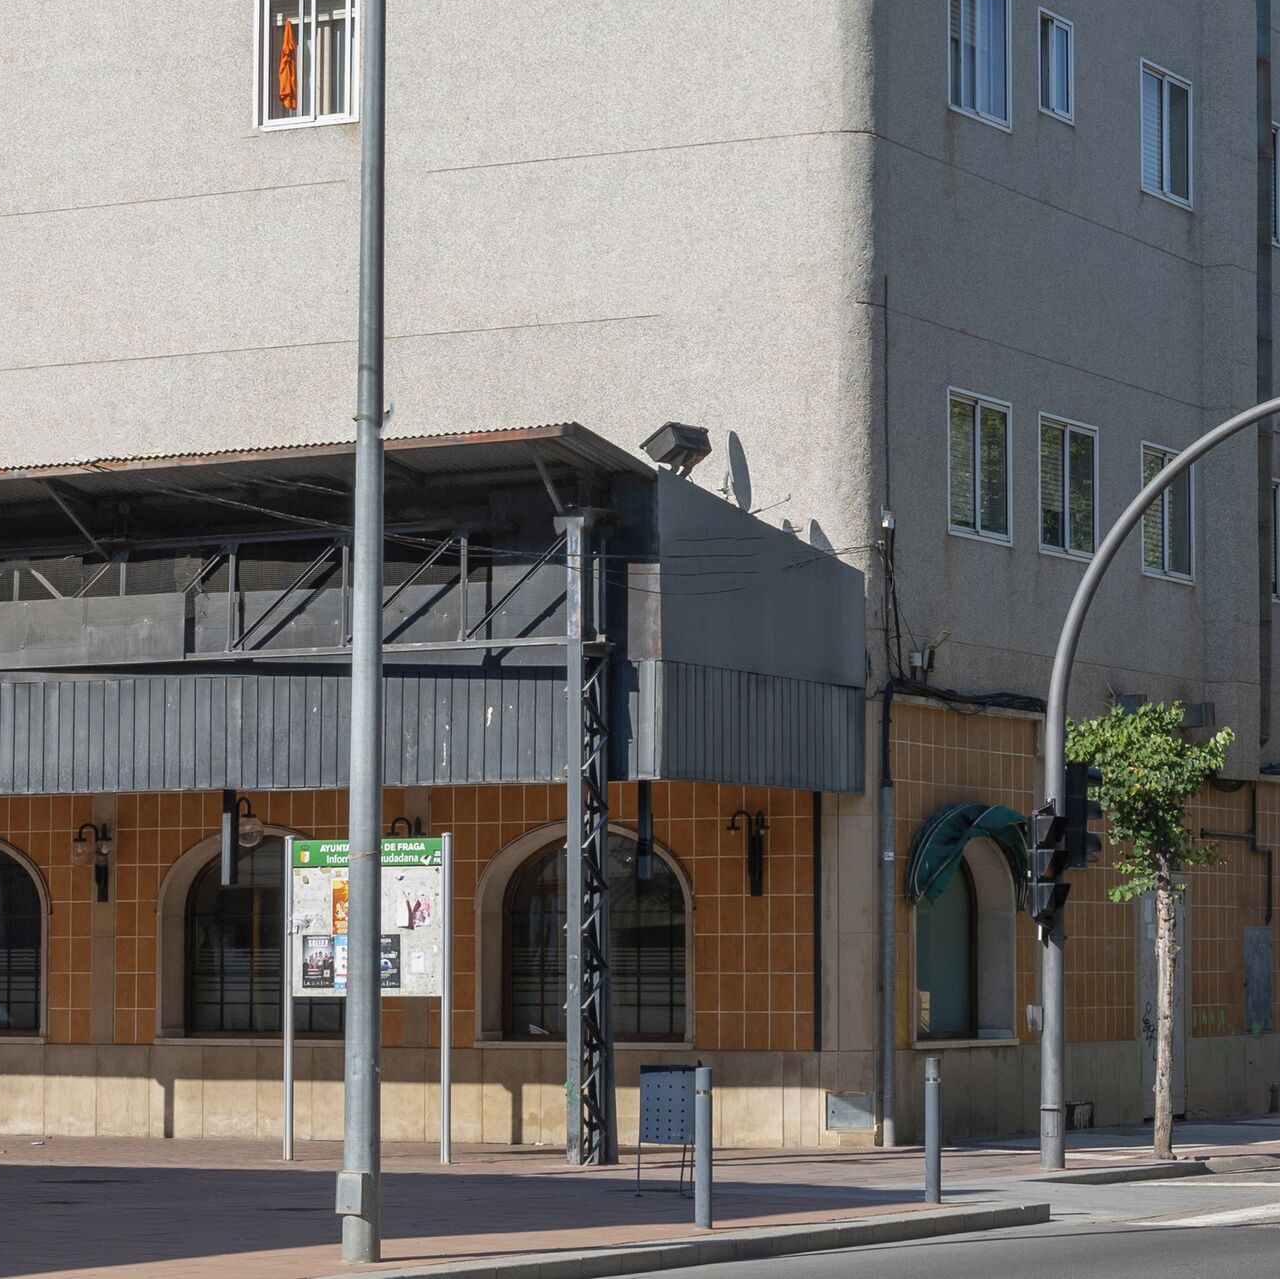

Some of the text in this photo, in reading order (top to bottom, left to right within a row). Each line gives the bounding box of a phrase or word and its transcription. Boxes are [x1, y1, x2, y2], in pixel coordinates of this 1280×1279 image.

[384, 843, 397, 851] DE
[397, 842, 426, 851] FRAGA
[381, 852, 419, 863] iudadana
